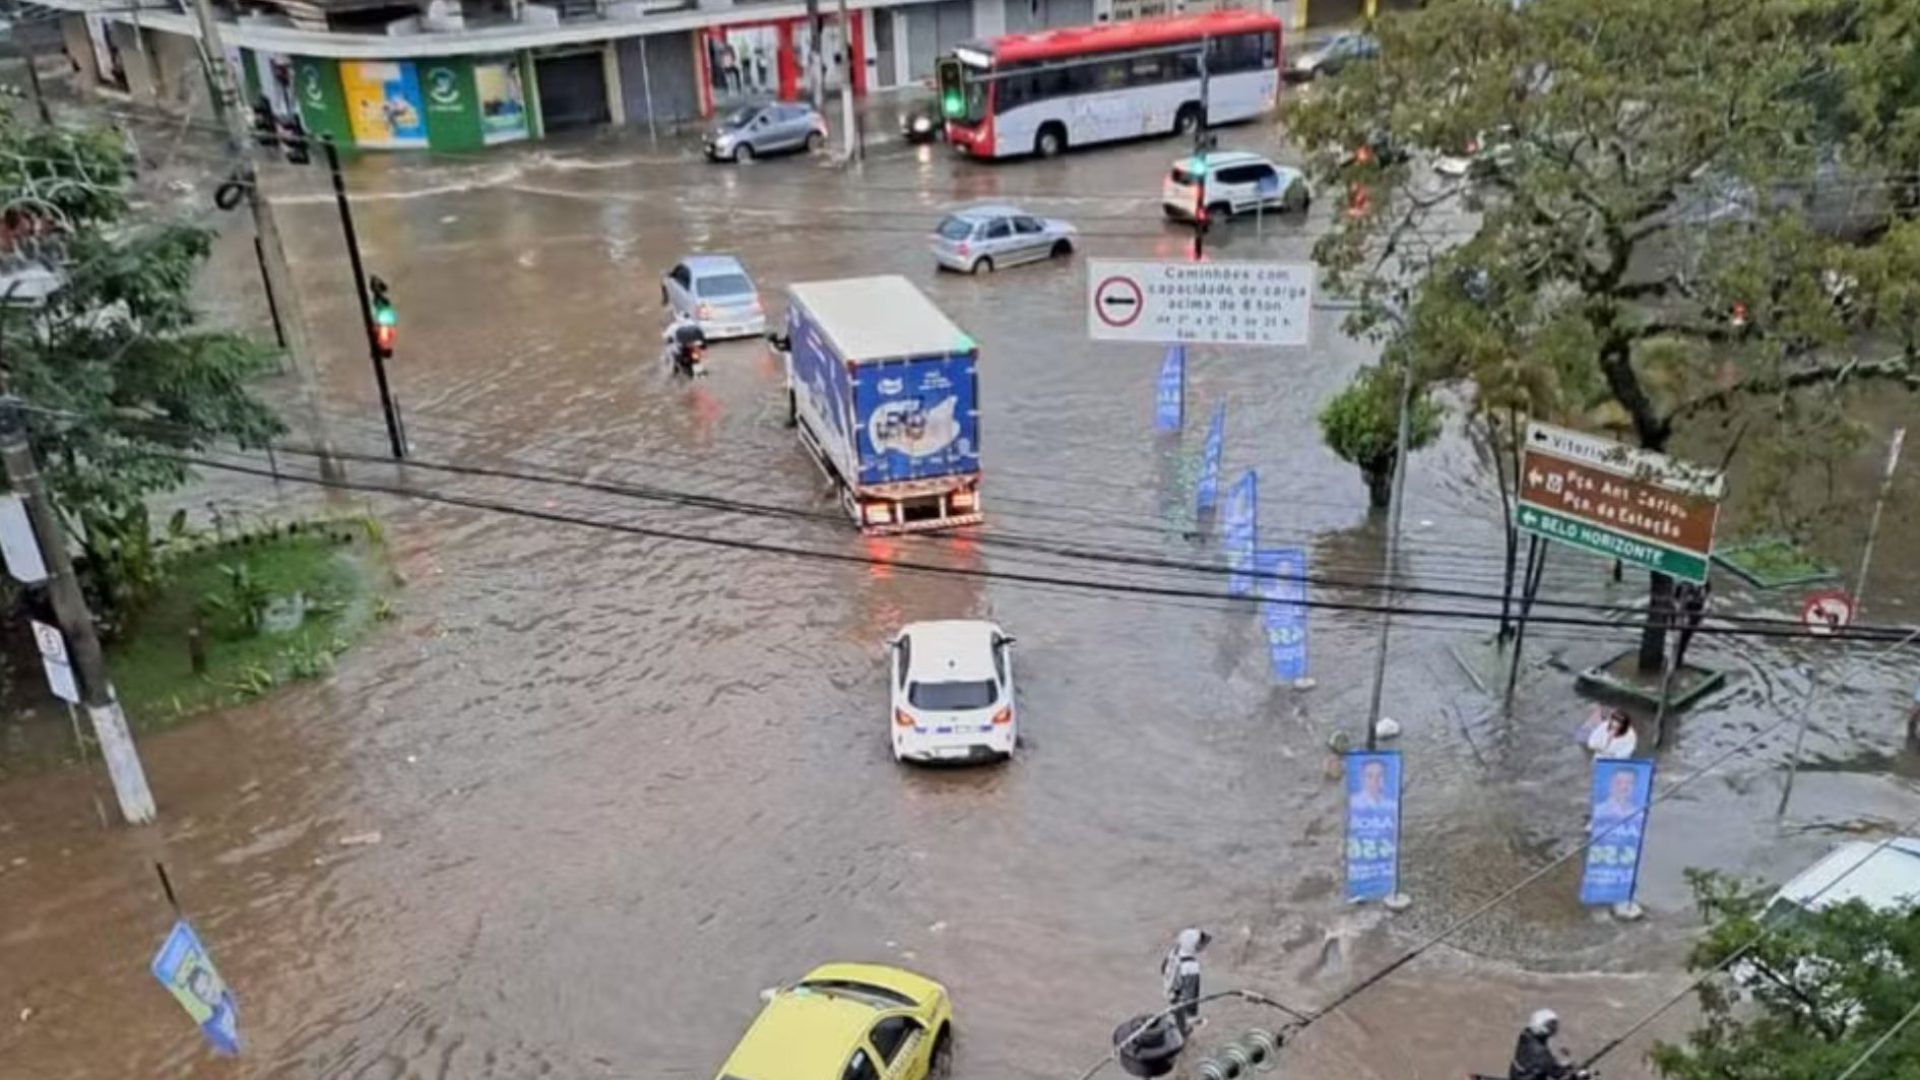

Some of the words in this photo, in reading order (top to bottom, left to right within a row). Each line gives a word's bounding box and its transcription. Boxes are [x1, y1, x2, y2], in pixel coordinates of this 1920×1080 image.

[1258, 269, 1290, 281] com
[1148, 282, 1234, 296] capacidade
[1240, 284, 1257, 296] de
[1264, 285, 1307, 301] carga
[1168, 297, 1212, 311] acima
[1219, 298, 1236, 311] de
[1257, 299, 1282, 312] ton
[1618, 507, 1681, 539] Estação
[1540, 516, 1577, 539] BELO
[1580, 527, 1666, 564] HORIZONTE
